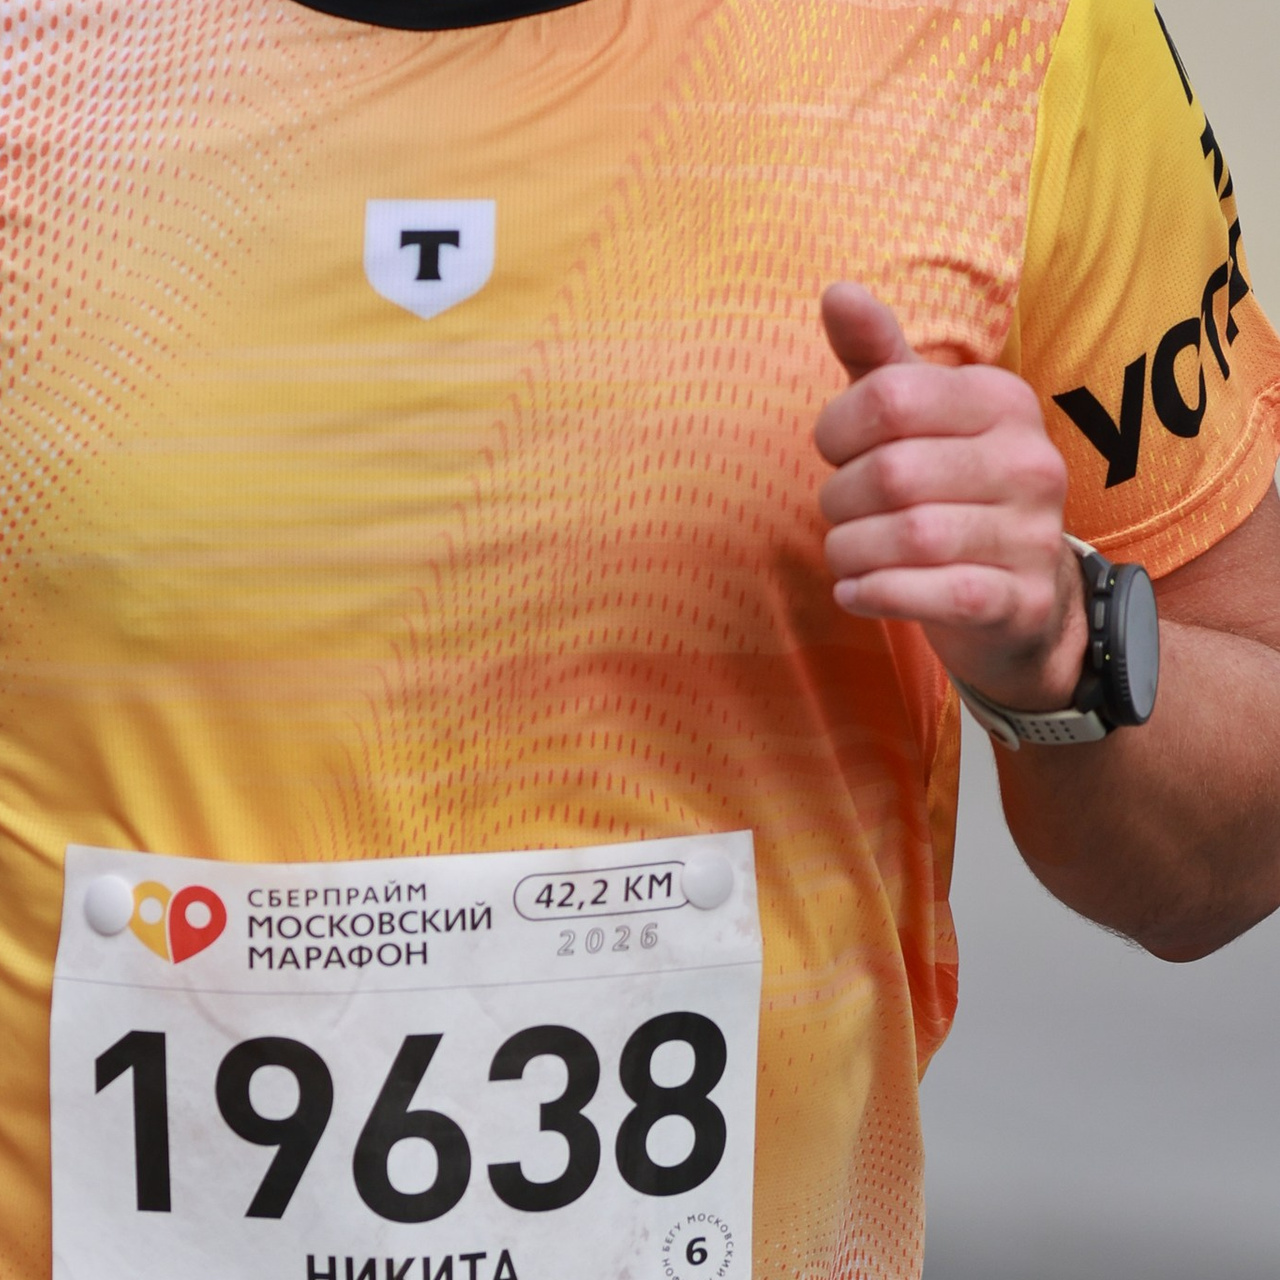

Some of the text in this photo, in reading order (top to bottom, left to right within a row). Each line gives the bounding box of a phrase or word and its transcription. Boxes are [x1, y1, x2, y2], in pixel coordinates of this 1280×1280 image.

[247, 880, 428, 908] СБЕРПРАЙМ
[535, 872, 673, 910] 42,2 КМ
[248, 901, 493, 939] МОСКОВСКИЙ
[248, 942, 429, 970] МАРАФОН
[557, 923, 659, 957] 2026
[95, 1011, 728, 1224] 19638
[662, 1222, 681, 1252] БЕГУ
[687, 1213, 734, 1277] МОСКОВСКИЙ
[686, 1237, 708, 1266] 6
